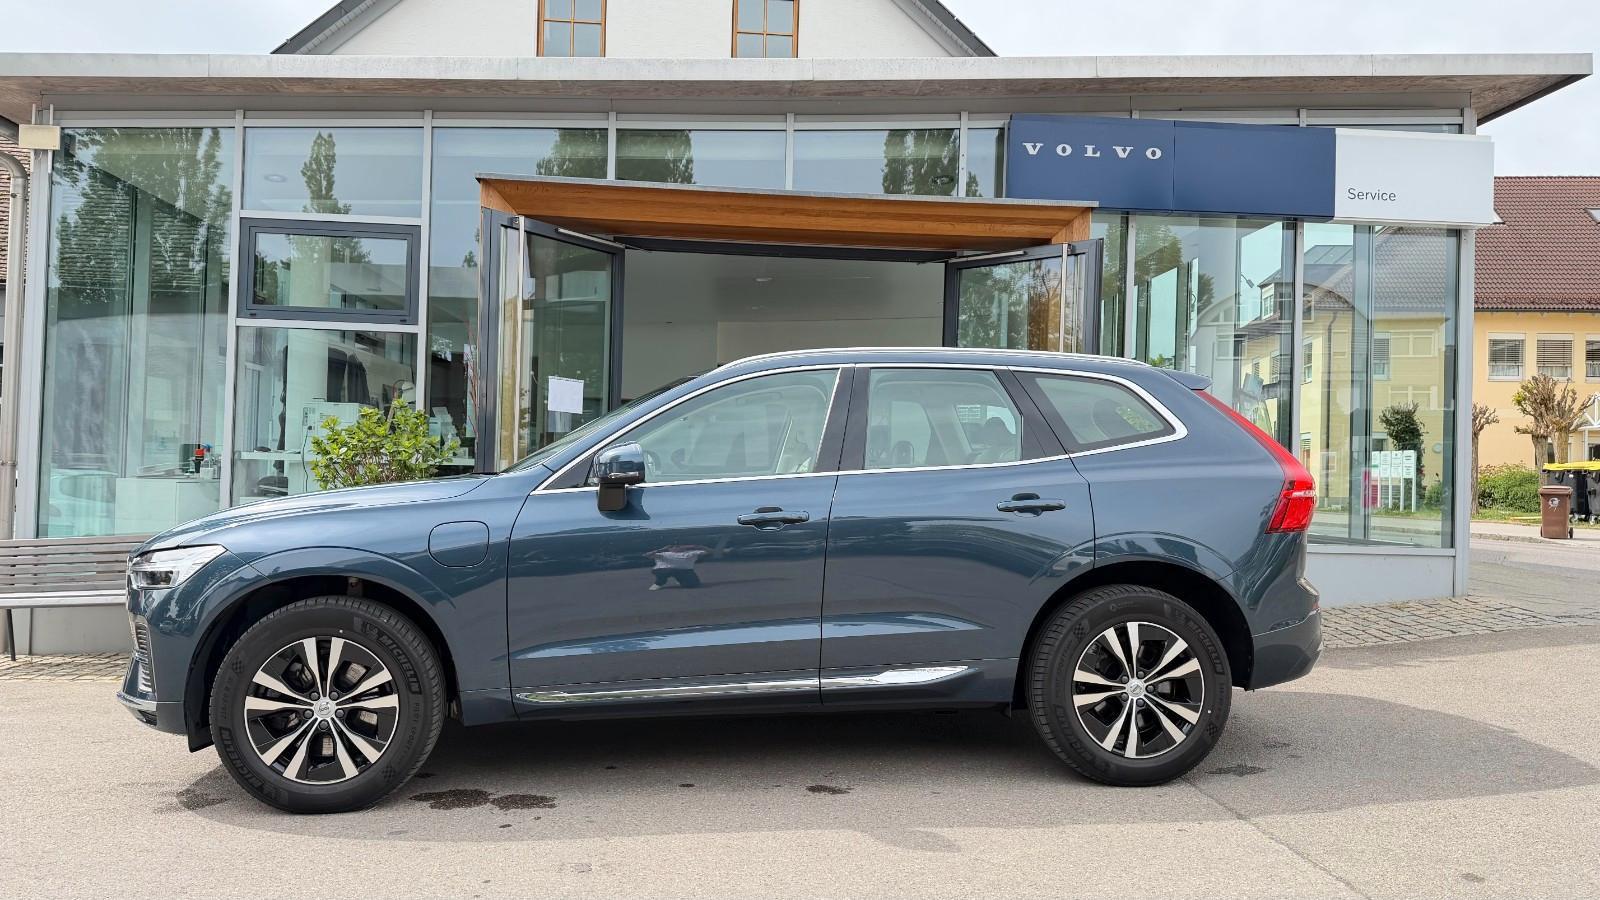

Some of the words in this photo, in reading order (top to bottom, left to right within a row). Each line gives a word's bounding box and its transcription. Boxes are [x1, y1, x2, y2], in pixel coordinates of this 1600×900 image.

[1022, 142, 1162, 160] VOLVO
[1347, 187, 1397, 202] Service
[377, 633, 421, 694] MICHELIN
